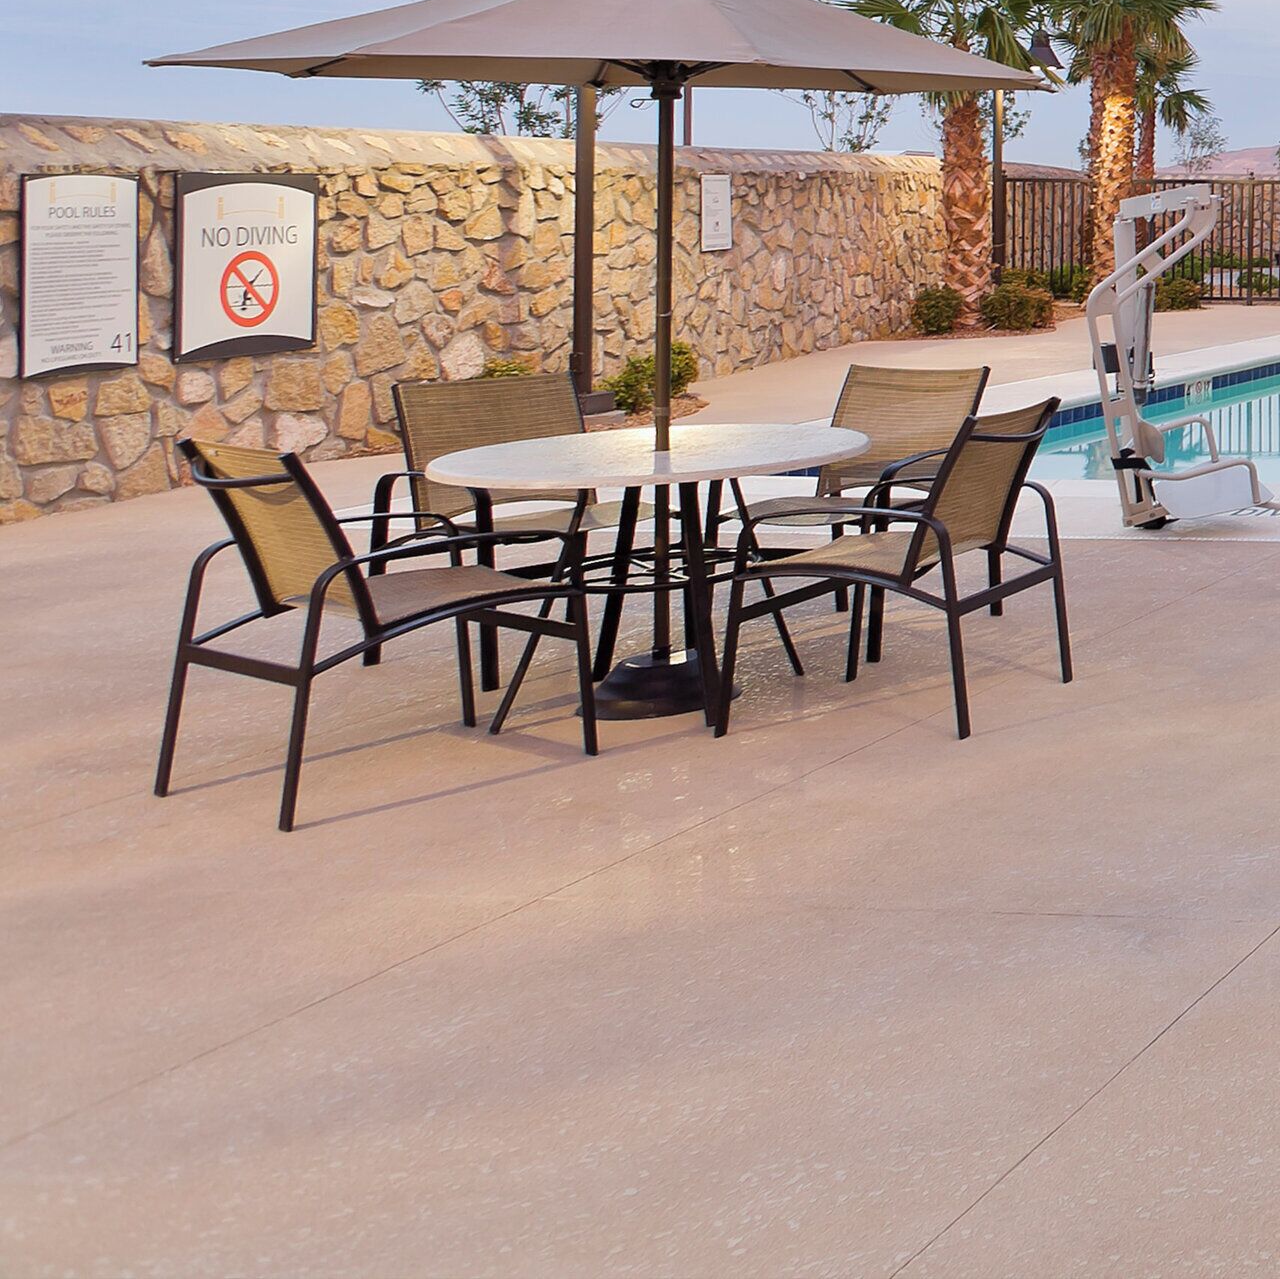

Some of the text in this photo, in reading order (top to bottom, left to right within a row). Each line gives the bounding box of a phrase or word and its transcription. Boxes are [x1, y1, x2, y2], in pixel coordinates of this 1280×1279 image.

[48, 206, 116, 219] POOL RULES
[201, 225, 299, 247] NO DIVING
[110, 332, 132, 353] 41
